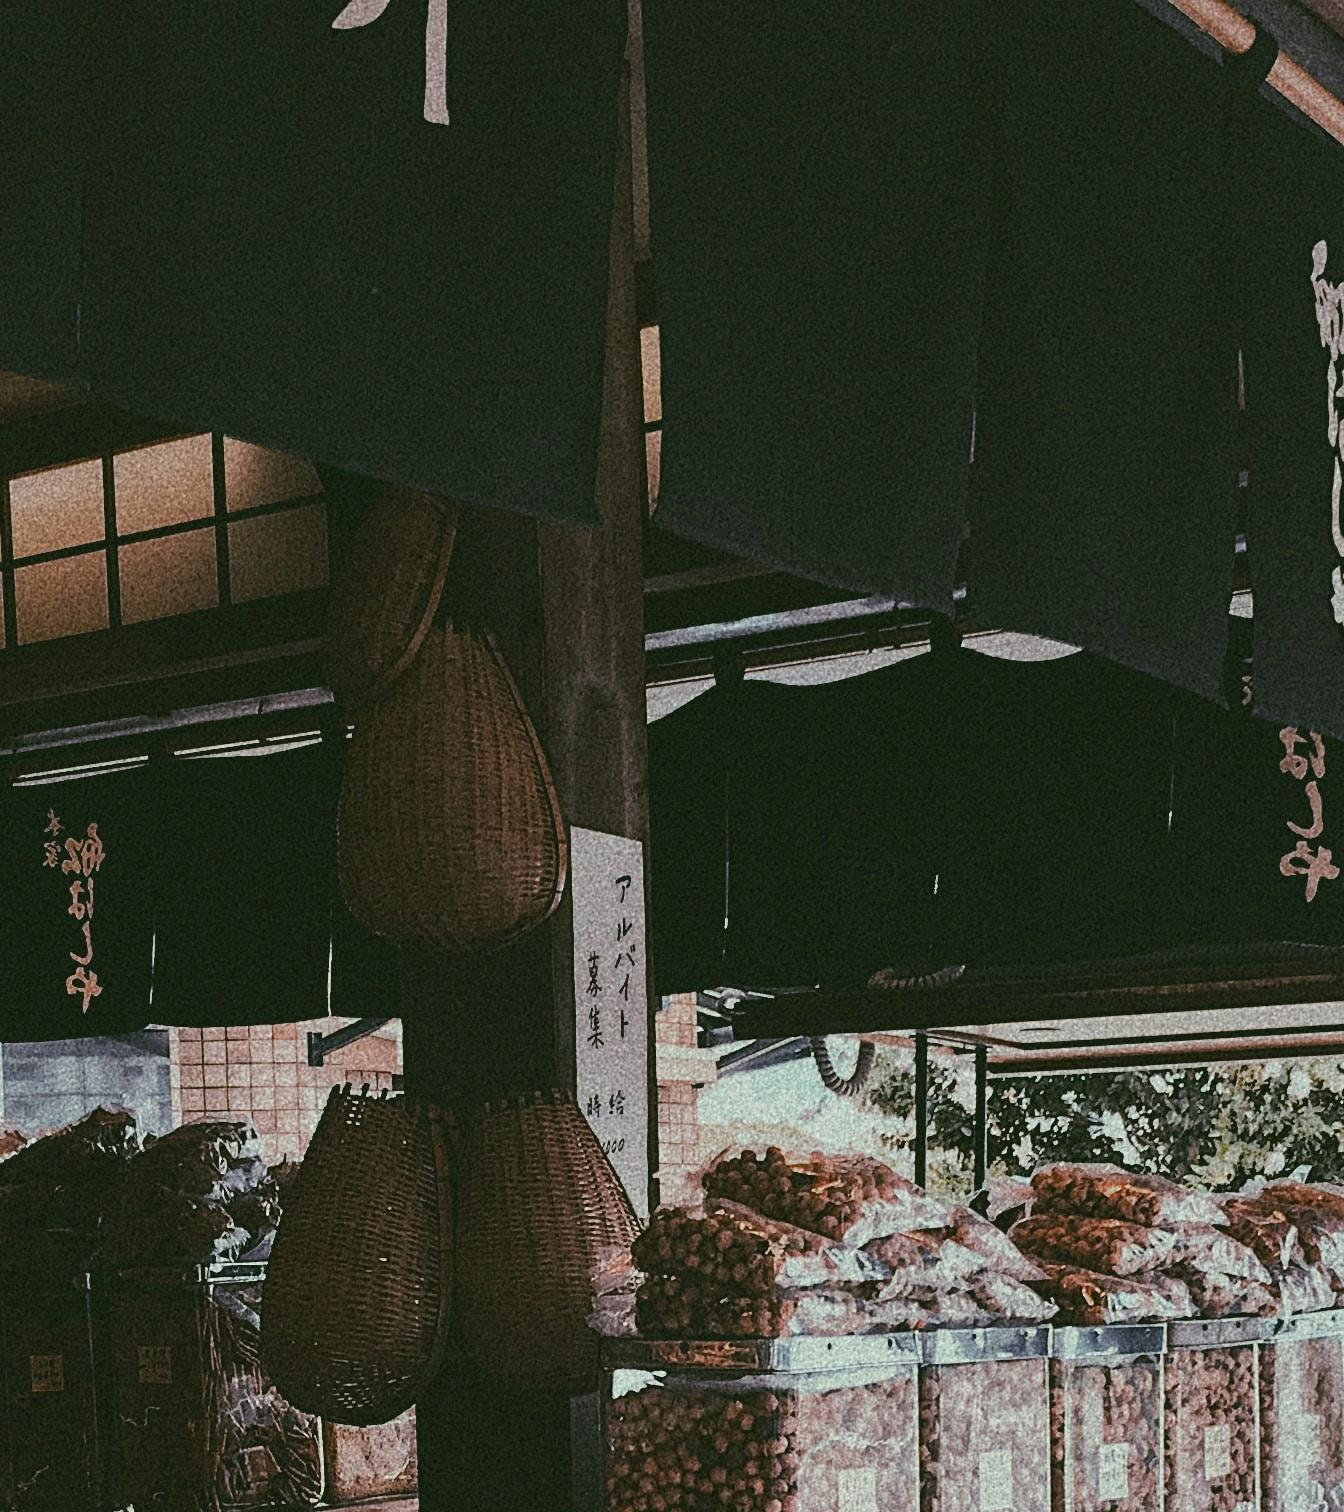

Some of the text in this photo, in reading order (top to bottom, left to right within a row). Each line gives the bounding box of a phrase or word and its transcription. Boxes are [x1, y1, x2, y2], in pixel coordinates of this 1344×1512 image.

[585, 952, 605, 1049] 募集
[614, 875, 636, 1039] アルバイト
[586, 1090, 626, 1119] 時給
